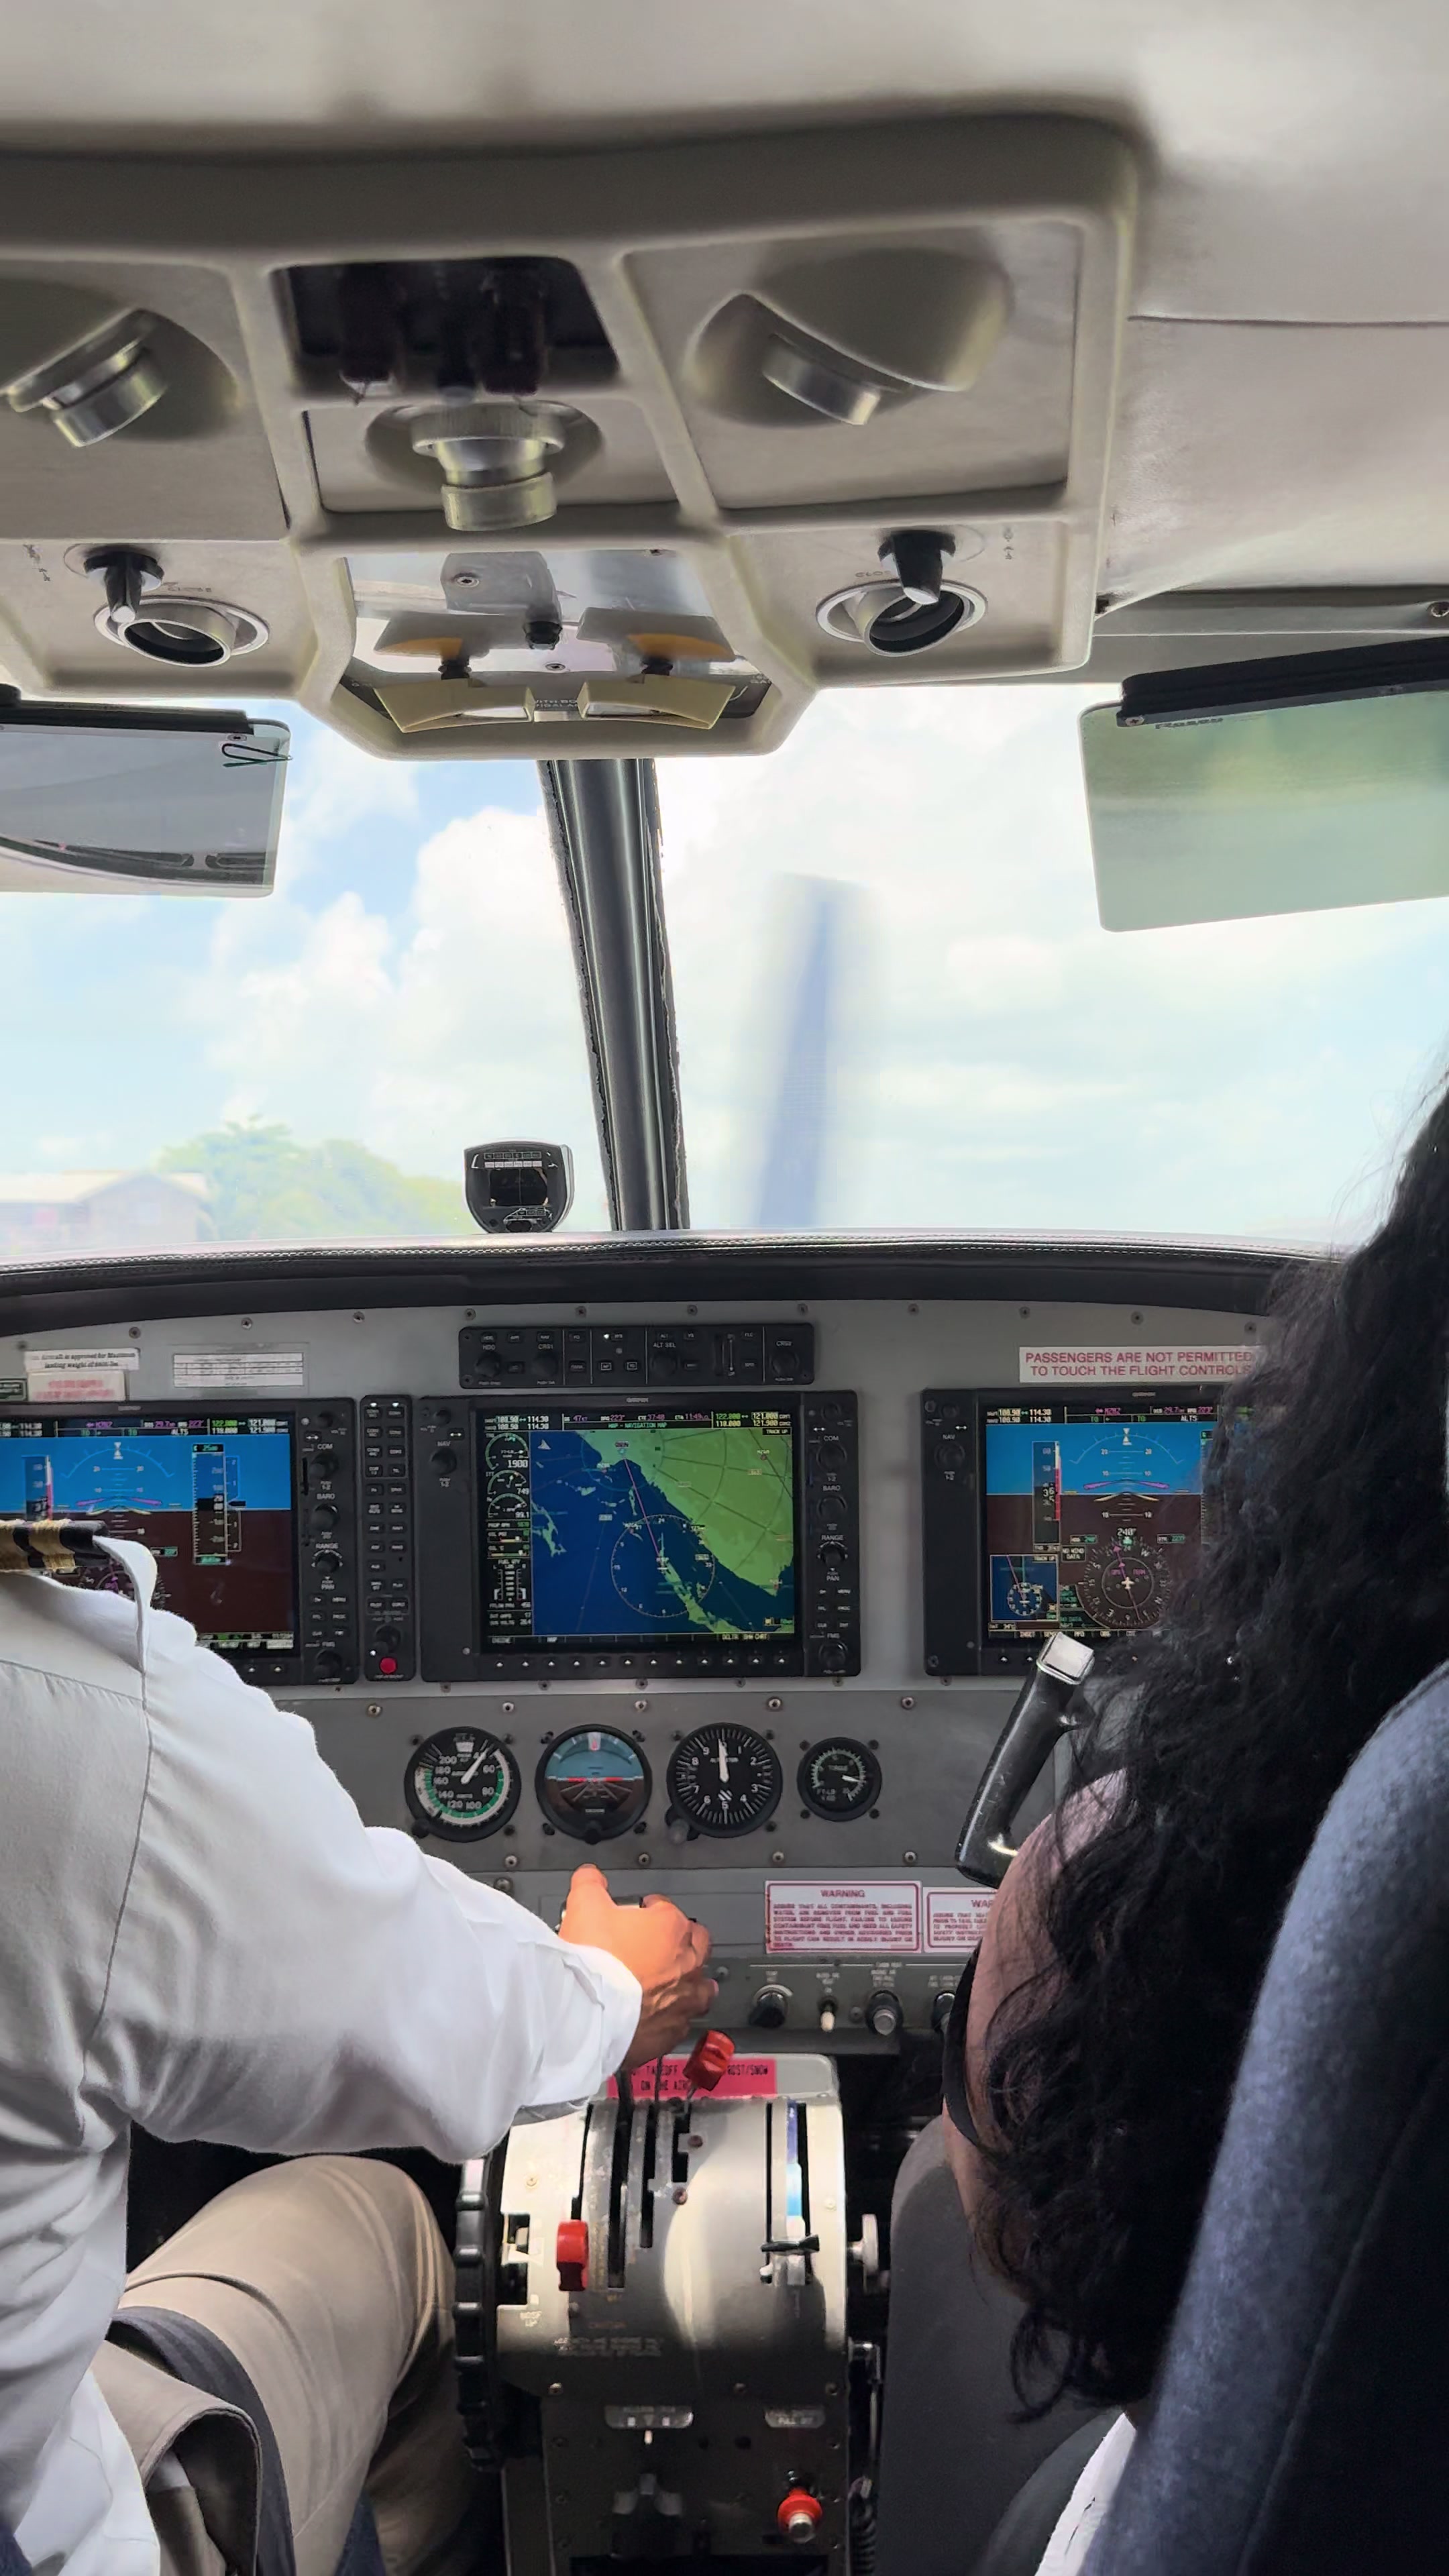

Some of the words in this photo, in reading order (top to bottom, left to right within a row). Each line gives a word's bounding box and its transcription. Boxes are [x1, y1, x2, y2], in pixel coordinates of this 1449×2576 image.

[1026, 1352, 1113, 1363] PASSENGERS
[1116, 1352, 1142, 1363] ARE
[1146, 1352, 1173, 1363] NOT
[1177, 1351, 1252, 1362] PERMITTED
[1030, 1365, 1048, 1376] TO
[1053, 1365, 1096, 1376] TOUCH
[1100, 1365, 1126, 1376] THE
[1130, 1365, 1175, 1376] FLIGHT
[702, 1747, 710, 1755] 9
[439, 1756, 458, 1764] 200
[692, 1757, 699, 1766] 8
[750, 1757, 757, 1766] 2
[435, 1766, 451, 1774] 180
[482, 1764, 495, 1773] 60
[482, 1786, 494, 1796] 80
[694, 1785, 700, 1794] 7
[751, 1784, 759, 1792] 3
[438, 1790, 454, 1799] 140
[740, 1794, 747, 1802] 4
[704, 1795, 711, 1804] 6
[447, 1800, 463, 1809] 120
[466, 1801, 482, 1809] 100
[721, 1801, 729, 1809] 5
[820, 1889, 865, 1898] WARNING
[727, 2064, 769, 2076] ROST/SNOW
